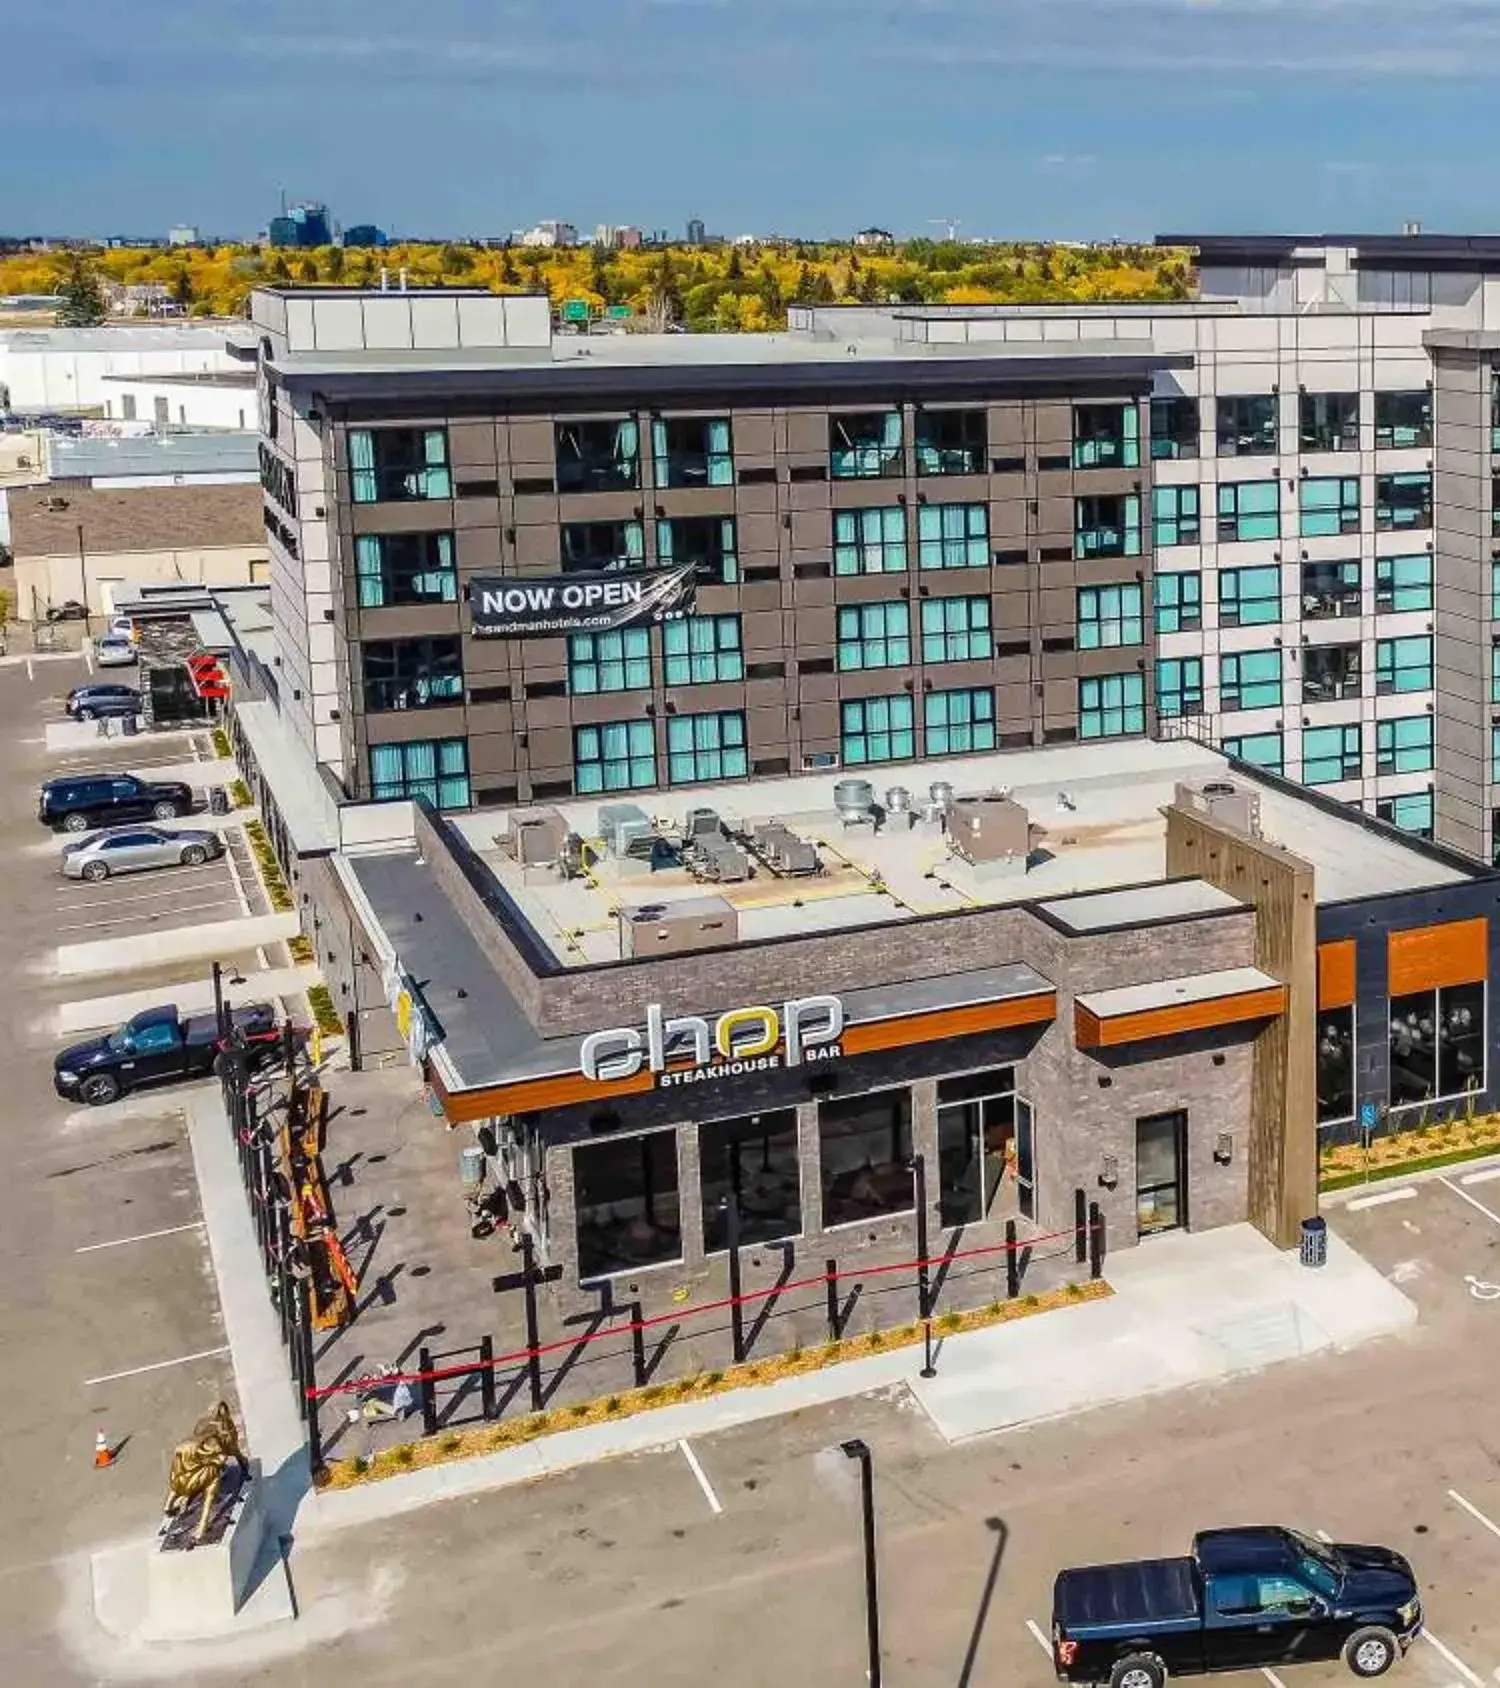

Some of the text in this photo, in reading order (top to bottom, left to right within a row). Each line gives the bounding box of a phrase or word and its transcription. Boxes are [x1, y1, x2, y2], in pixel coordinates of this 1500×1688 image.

[482, 581, 641, 615] NOW OPEN
[580, 994, 844, 1081] chop
[660, 1045, 841, 1088] STEAKHOUSE BAR
